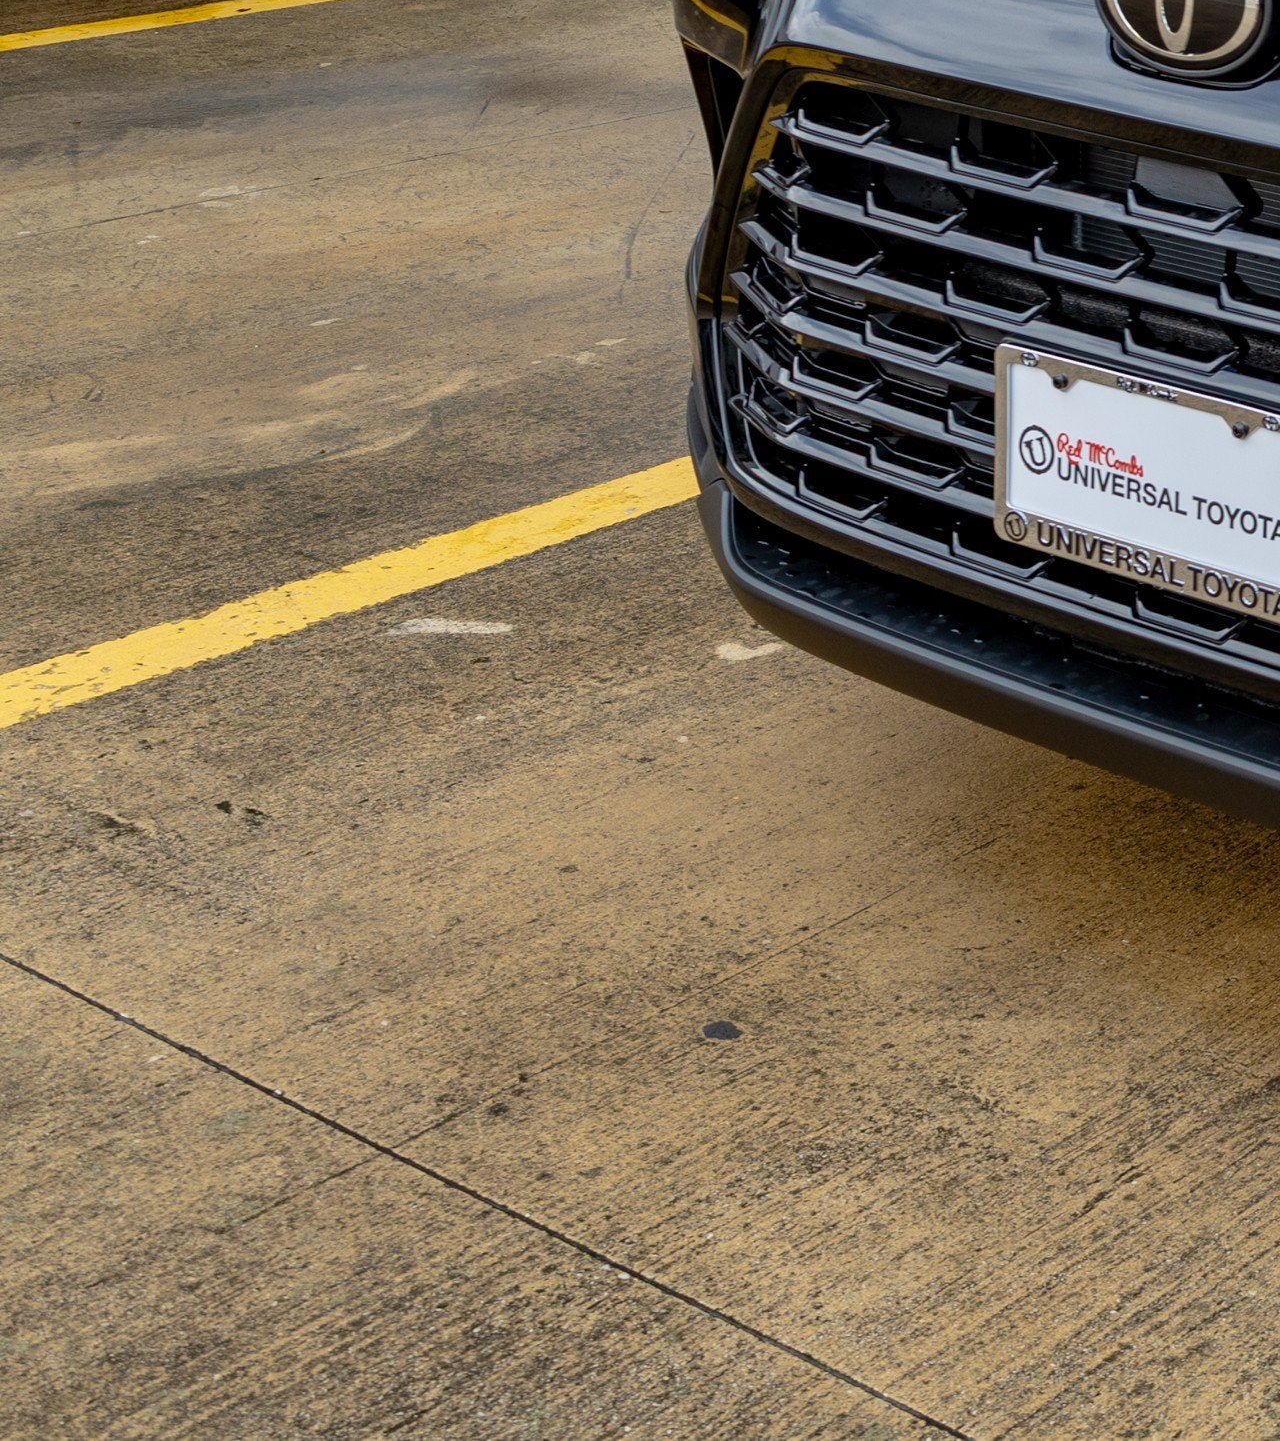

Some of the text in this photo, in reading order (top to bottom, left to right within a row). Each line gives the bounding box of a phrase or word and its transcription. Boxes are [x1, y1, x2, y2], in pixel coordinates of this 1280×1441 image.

[1056, 433, 1144, 477] Red McCombs
[1057, 457, 1187, 516] UNIVERSAL
[1037, 519, 1185, 587] UNIVERSAL
